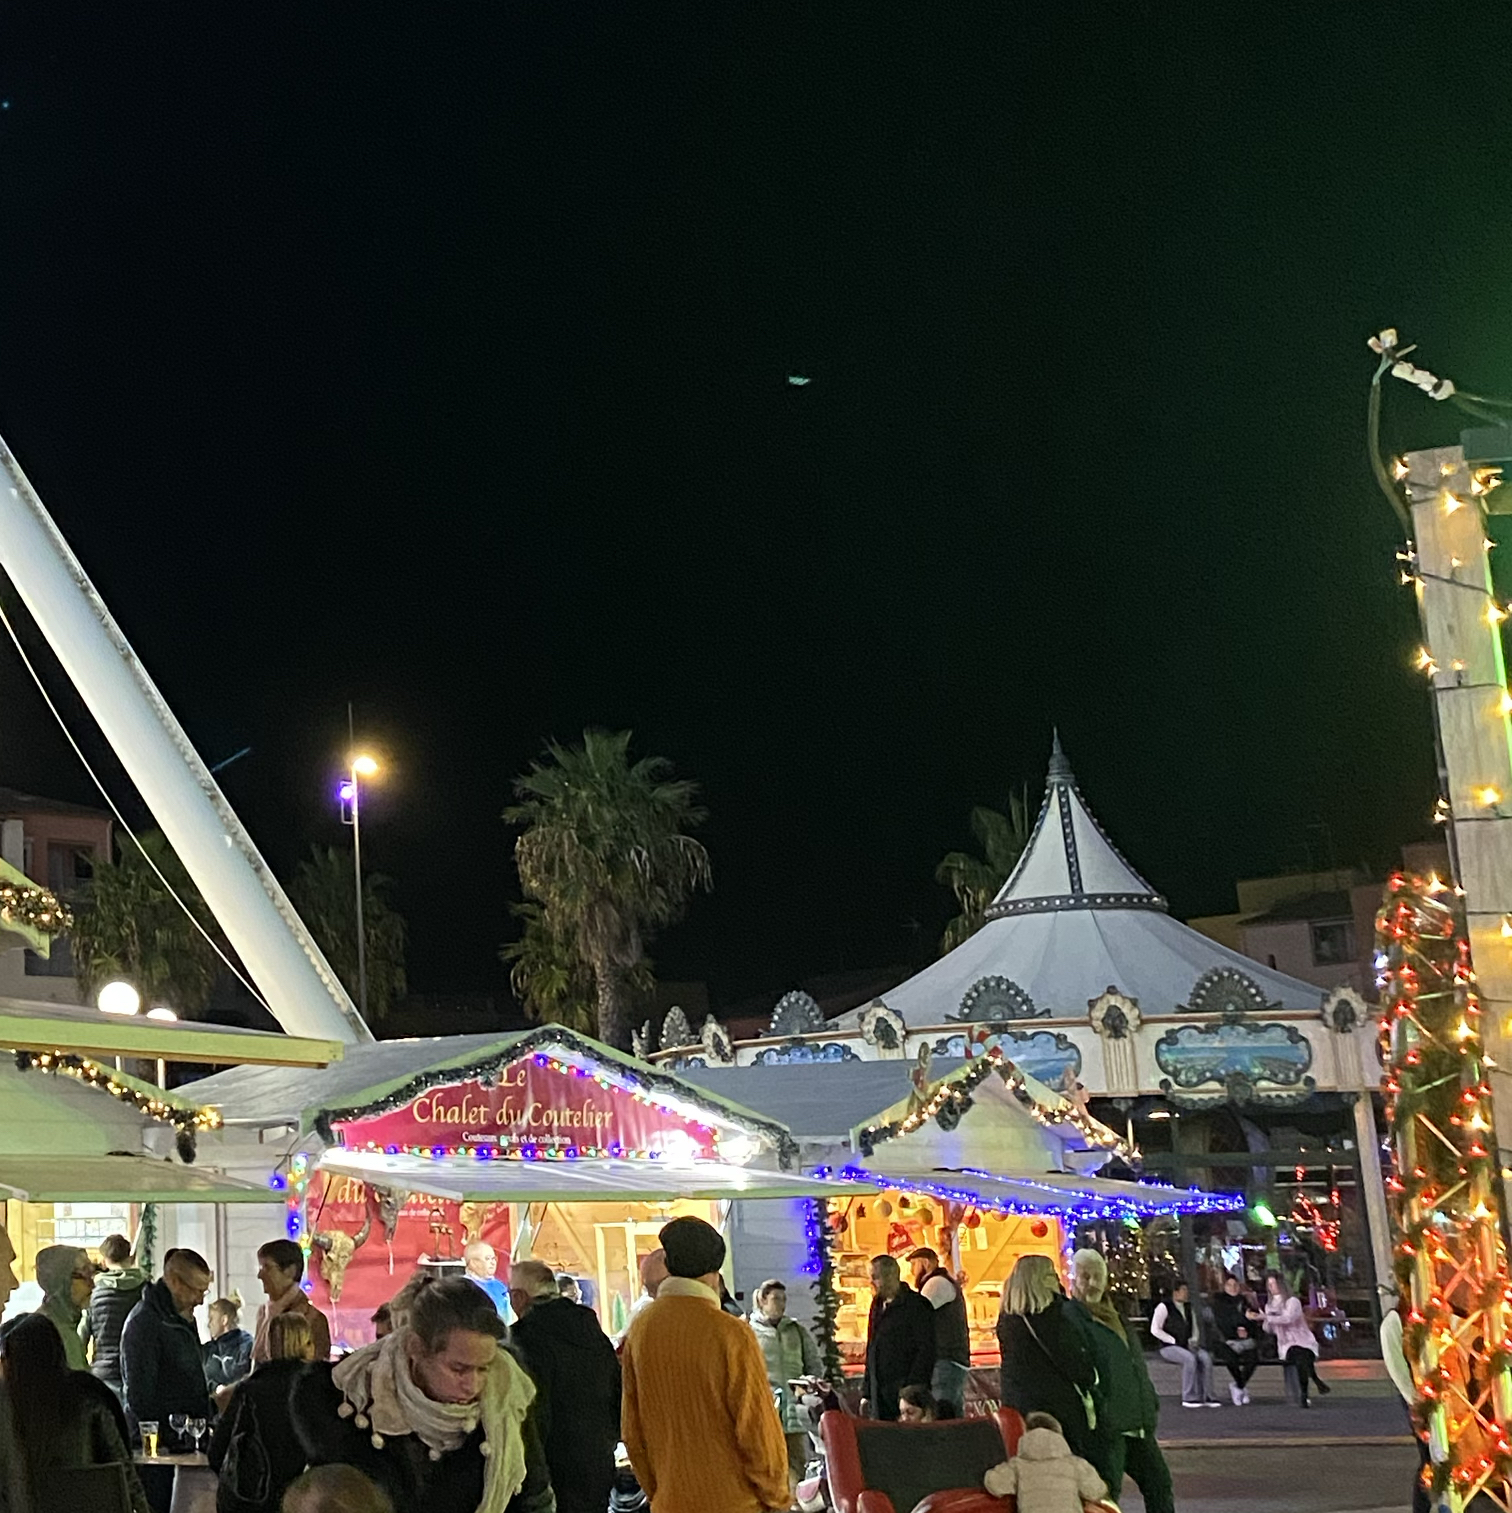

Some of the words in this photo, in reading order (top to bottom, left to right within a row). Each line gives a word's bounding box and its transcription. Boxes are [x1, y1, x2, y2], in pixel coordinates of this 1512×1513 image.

[498, 1066, 527, 1087] Le
[413, 1092, 490, 1125] Chalet
[495, 1095, 525, 1126] du
[528, 1098, 614, 1128] Coutelier
